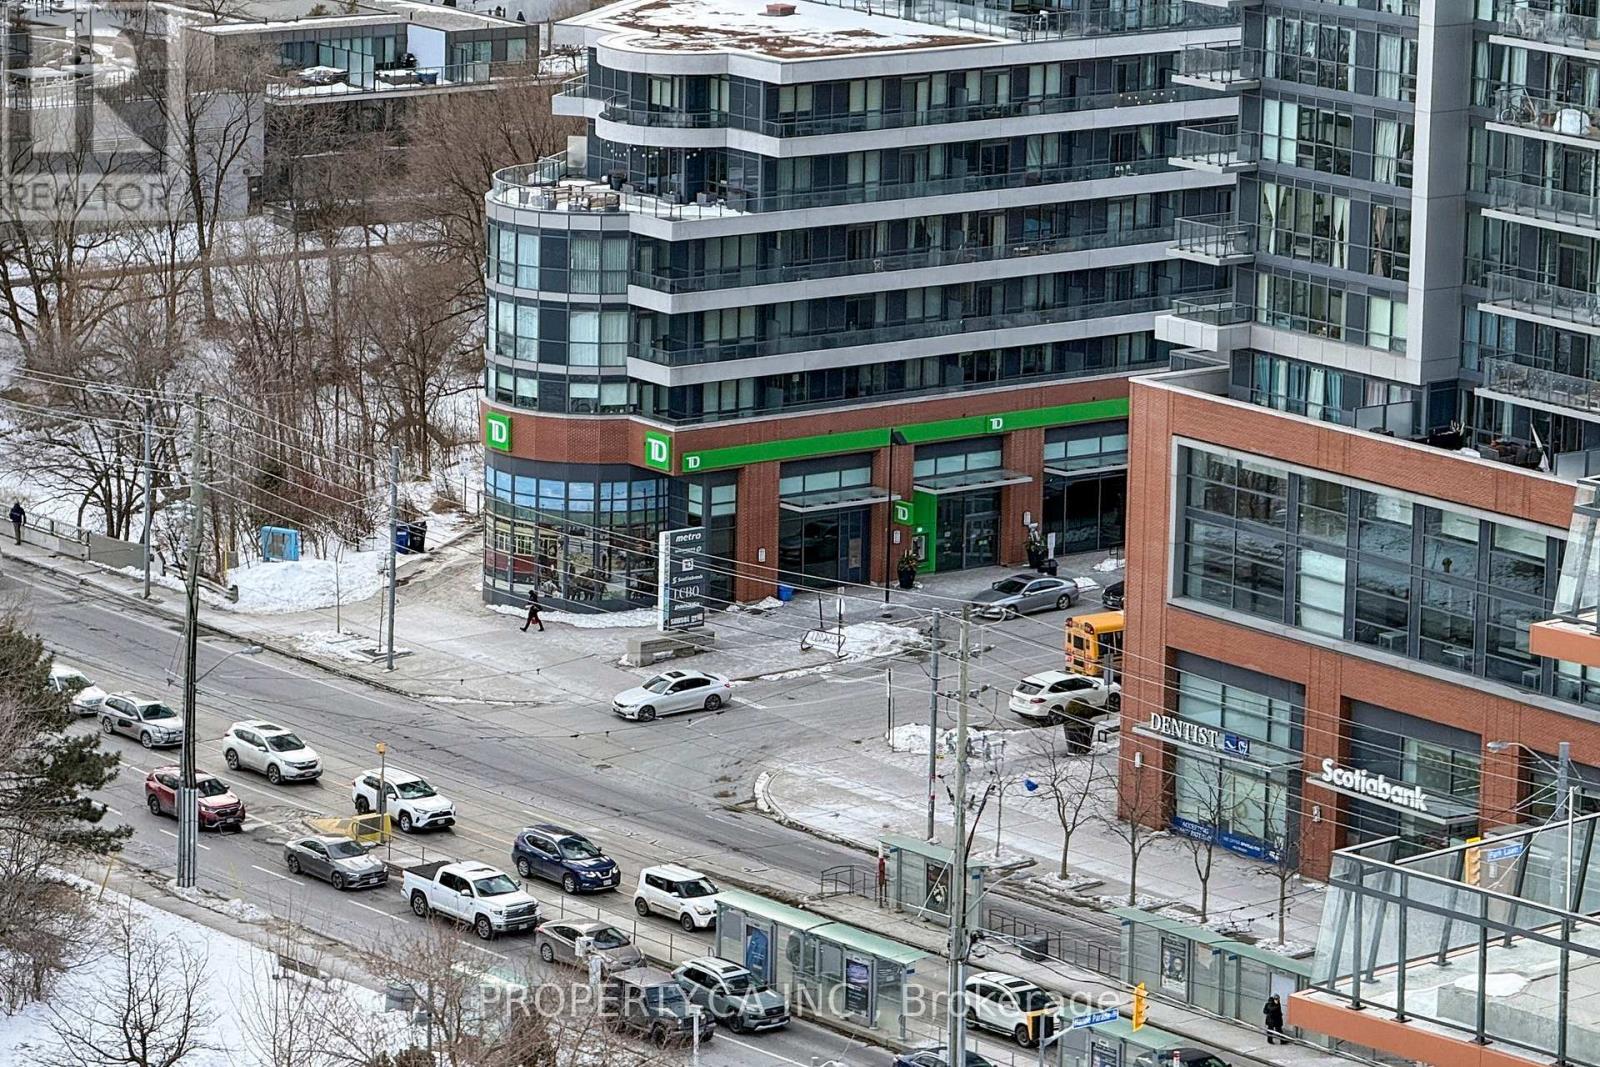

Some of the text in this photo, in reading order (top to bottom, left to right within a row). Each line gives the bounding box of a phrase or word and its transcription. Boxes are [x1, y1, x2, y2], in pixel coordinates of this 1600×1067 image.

[488, 419, 507, 443] TD
[990, 417, 1003, 430] TD
[647, 437, 667, 462] TD
[685, 455, 701, 469] TD
[896, 505, 909, 521] TD
[675, 532, 702, 542] metro
[1149, 712, 1218, 748] DENTIST
[1321, 757, 1428, 811] Scotiabank
